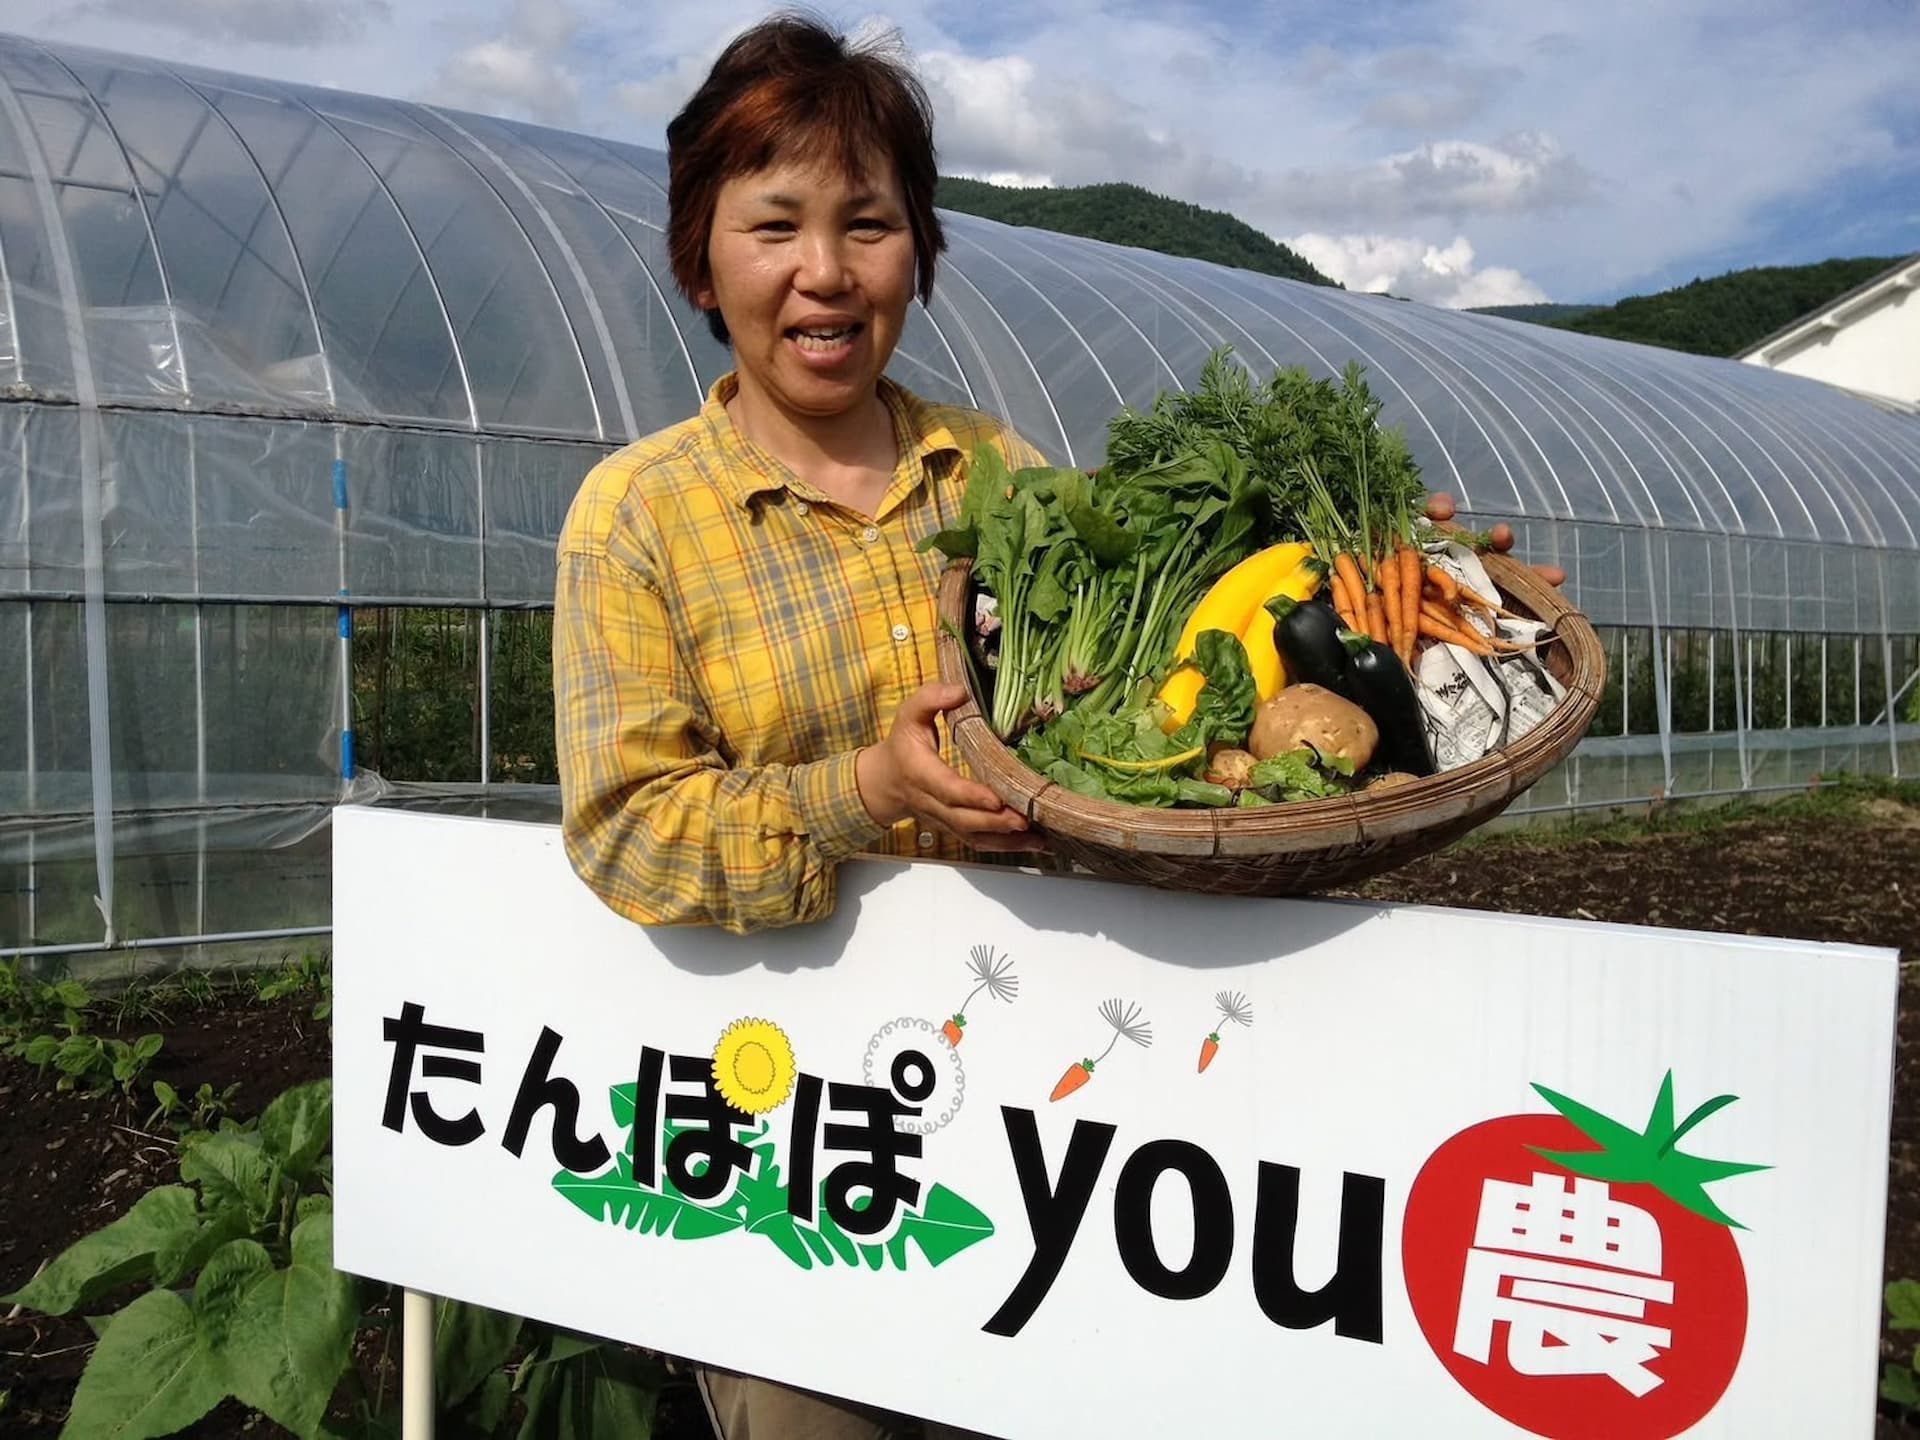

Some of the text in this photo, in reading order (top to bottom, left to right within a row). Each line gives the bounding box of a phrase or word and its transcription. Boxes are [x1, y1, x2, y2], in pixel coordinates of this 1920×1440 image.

[383, 1001, 1674, 1398] たんぽぽ you 農
